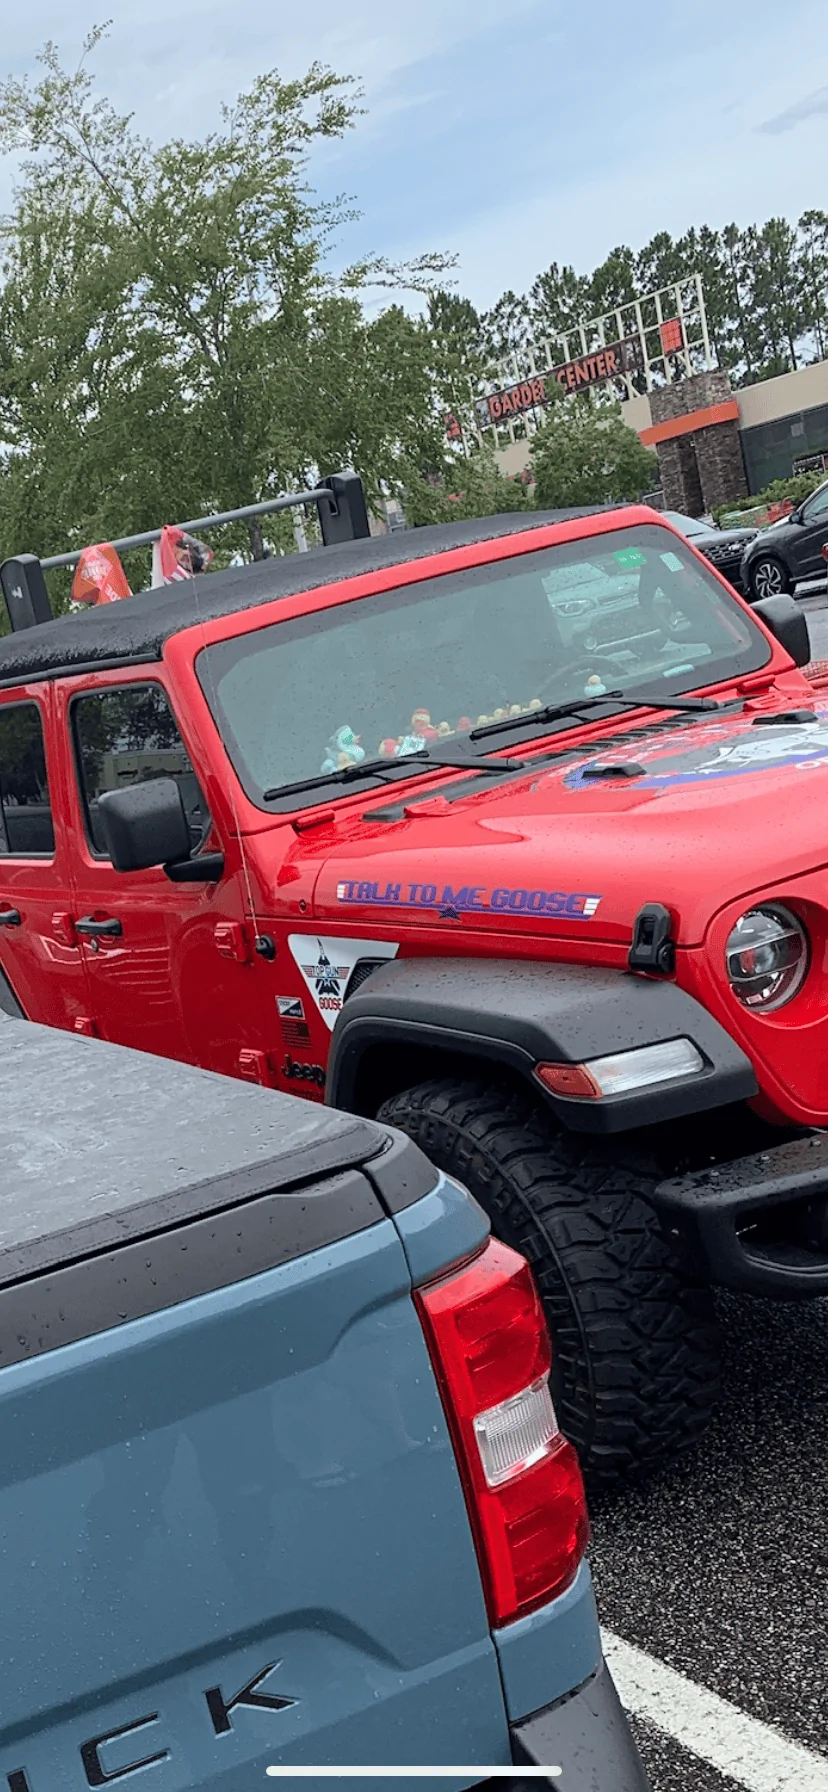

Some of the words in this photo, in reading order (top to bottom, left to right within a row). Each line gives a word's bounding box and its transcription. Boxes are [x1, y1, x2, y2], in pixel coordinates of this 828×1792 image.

[556, 350, 618, 392] CENTER
[342, 880, 401, 902] TALK
[407, 883, 437, 904] TO
[441, 885, 487, 907] ME
[490, 888, 586, 915] GOOSE
[319, 997, 343, 1011] GOOSE
[280, 1053, 326, 1088] Jeep
